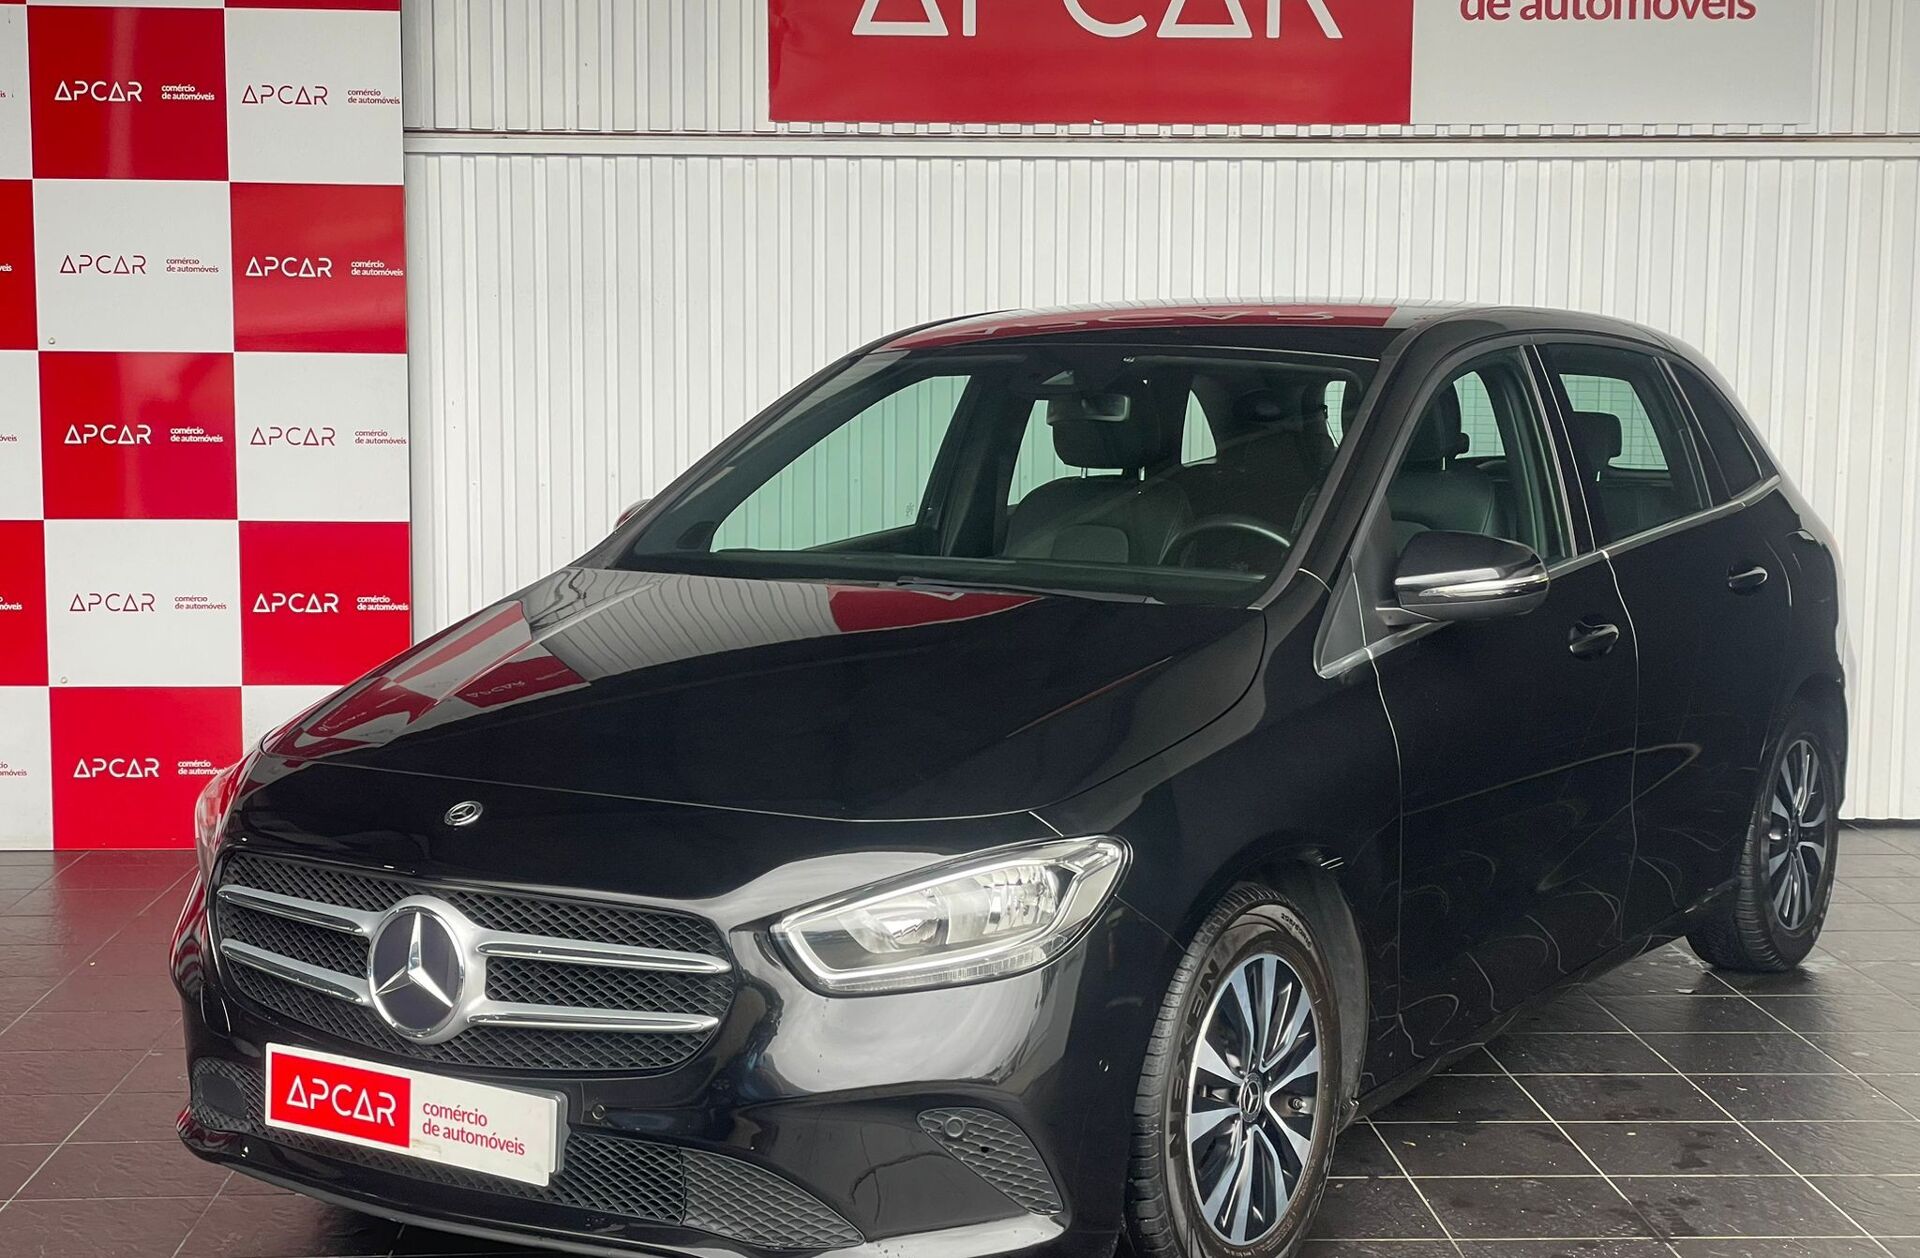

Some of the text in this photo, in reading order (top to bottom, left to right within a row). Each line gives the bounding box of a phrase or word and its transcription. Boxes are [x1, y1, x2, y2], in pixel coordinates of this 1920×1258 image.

[55, 80, 143, 101] APCAR
[162, 84, 196, 92] comércio
[162, 92, 215, 100] de automóveis
[242, 84, 328, 105] APCAR
[347, 88, 381, 96] comércio
[60, 254, 147, 275] APCAR
[246, 257, 333, 278] APCAR
[361, 268, 404, 276] automóveis
[64, 424, 152, 445] APCAR
[170, 426, 204, 434] comércio
[181, 434, 223, 442] automóveis
[250, 426, 336, 447] APCAR
[69, 592, 156, 612] APCAR
[253, 592, 339, 613] APCAR
[357, 595, 391, 603] comércio
[367, 602, 409, 610] automóveis
[74, 757, 160, 779] APCAR
[178, 767, 188, 775] de
[1169, 958, 1221, 1159] NEXEN
[286, 1075, 396, 1127] APCAR
[422, 1102, 488, 1127] comércio
[422, 1118, 526, 1156] de automóveis
